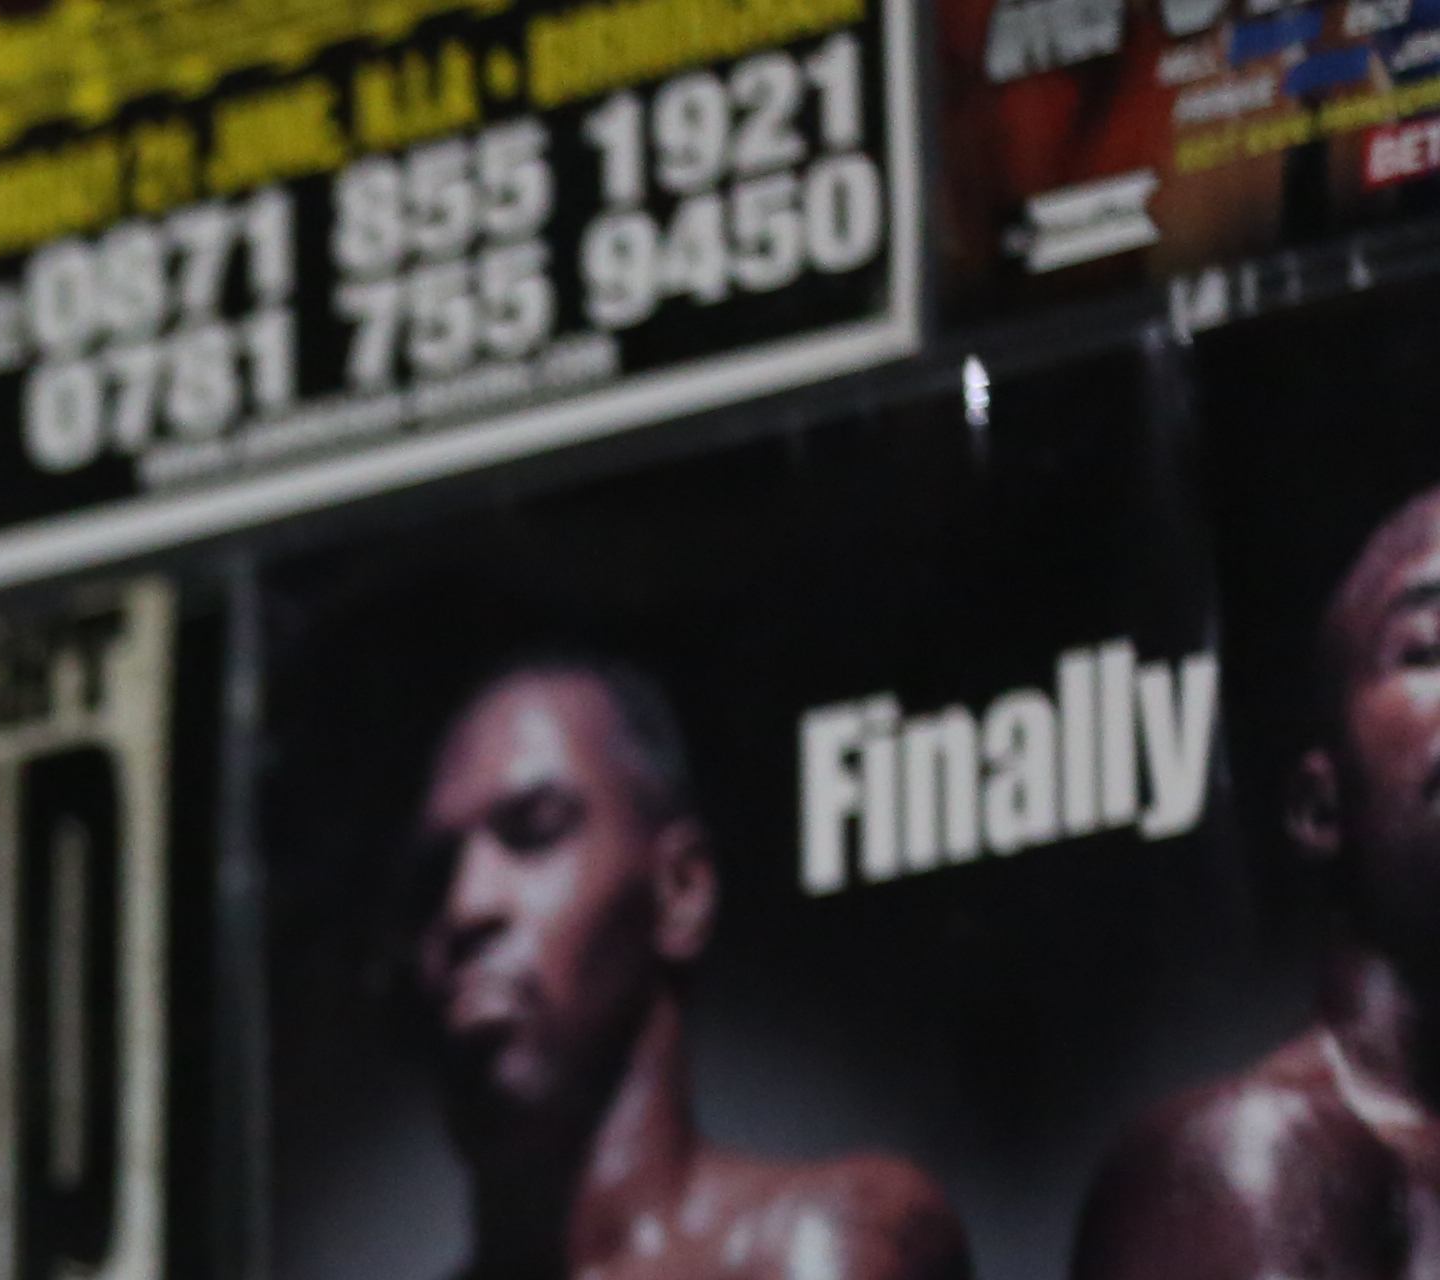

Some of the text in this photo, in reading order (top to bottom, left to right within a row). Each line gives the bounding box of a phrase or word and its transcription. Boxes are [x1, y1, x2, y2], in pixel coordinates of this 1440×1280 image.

[24, 188, 296, 362] 0871
[334, 118, 554, 277] 855
[587, 34, 862, 204] 1921
[24, 308, 296, 473] 0781
[334, 243, 556, 392] 755
[582, 154, 882, 329] 9450
[798, 636, 1220, 898] Finally
